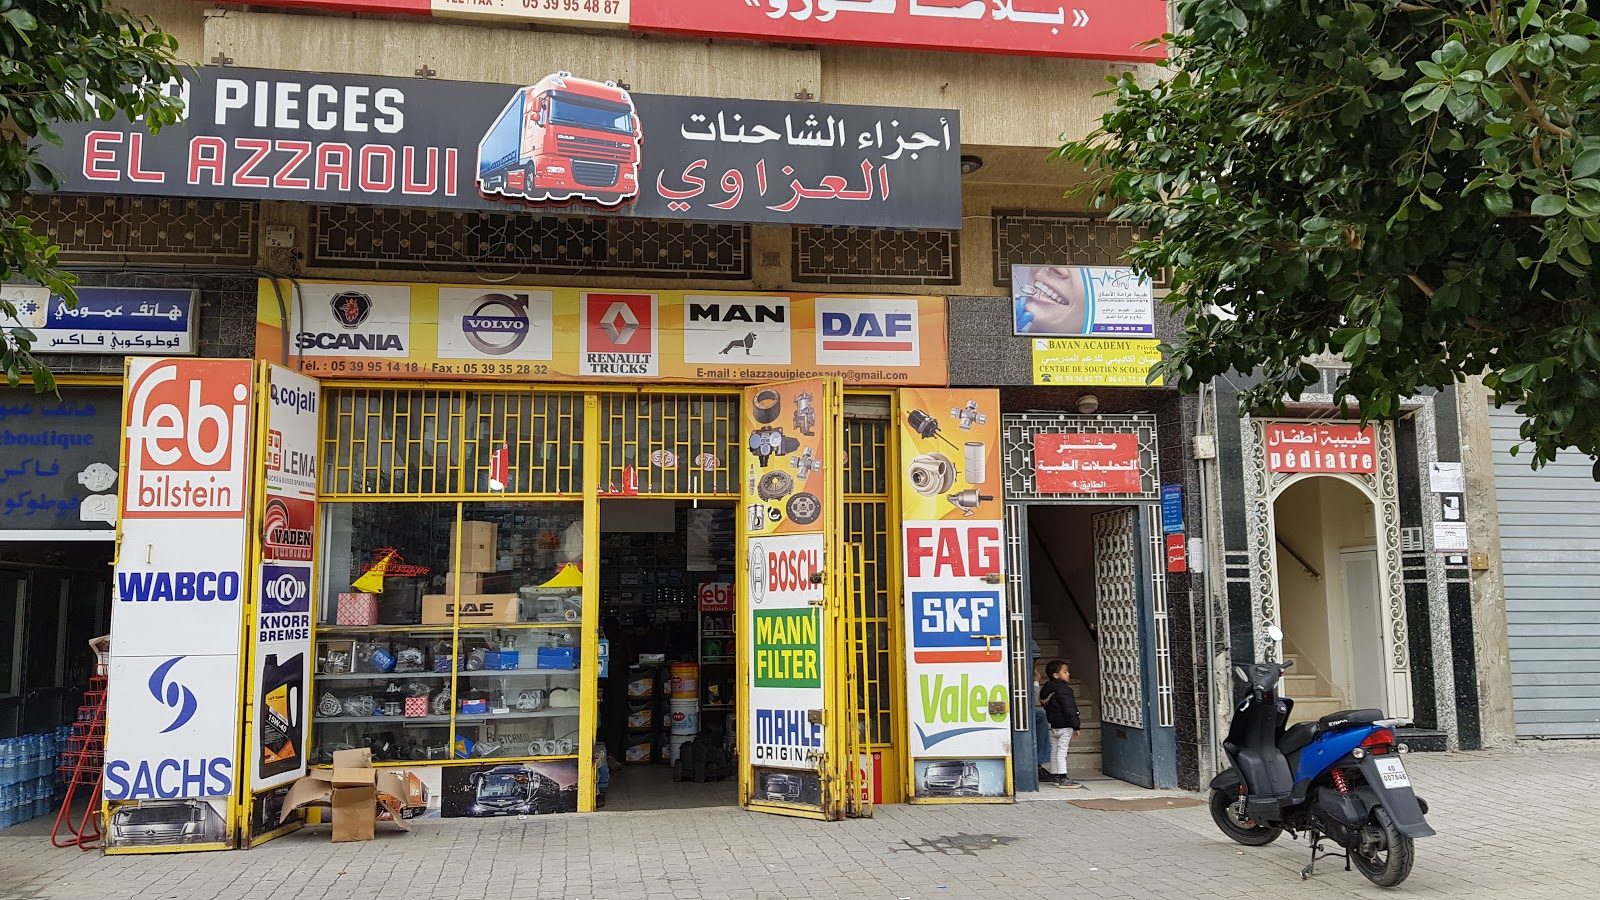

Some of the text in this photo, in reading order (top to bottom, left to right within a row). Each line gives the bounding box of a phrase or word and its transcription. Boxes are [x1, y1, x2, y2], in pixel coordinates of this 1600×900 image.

[564, 0, 579, 11] 95
[584, 0, 599, 13] 48
[604, 0, 620, 14] 87
[214, 78, 405, 134] PIECES
[680, 109, 951, 160] أجزاء الشاحنات
[82, 130, 458, 197] EL AZZAOUI
[656, 158, 889, 212] العزاوي
[54, 296, 182, 320] هاتف عمومي
[690, 303, 785, 323] MAN
[468, 319, 524, 329] VOLVO
[822, 312, 912, 337] DAF
[49, 331, 180, 350] فوطوكوبي فاكس
[295, 332, 404, 351] SCANIA
[1049, 341, 1080, 349] BAYAN
[1083, 341, 1131, 350] ACADEMY
[299, 360, 319, 371] Tél.
[331, 361, 345, 371] 05
[350, 361, 363, 371] 39
[368, 362, 381, 372] 95
[387, 362, 400, 372] 14
[405, 362, 417, 372] 18
[432, 363, 452, 373] Fax
[464, 363, 477, 373] 05
[482, 364, 495, 374] 39
[499, 364, 513, 374] 35
[517, 364, 530, 374] 28
[534, 364, 548, 374] 32
[587, 353, 651, 363] RENAULT
[590, 364, 647, 374] TRUCKS
[696, 368, 730, 378] E-mail
[280, 386, 315, 415] cojali
[126, 365, 248, 480] febi
[1056, 438, 1117, 454] مختبر
[1269, 427, 1371, 448] طبيبة أطفال
[284, 449, 316, 479] LEMA
[1038, 459, 1138, 474] التحليلات الطبية
[1270, 448, 1372, 470] pédiatre
[138, 475, 230, 507] bilstein
[275, 528, 311, 546] VADEN
[907, 528, 1000, 577] FAG
[769, 549, 818, 592] BOSCH
[118, 571, 239, 602] WABCO
[446, 603, 493, 612] DAF
[922, 598, 994, 632] SKF
[261, 614, 309, 629] KNORR
[757, 615, 817, 645] MANN
[260, 628, 309, 642] BREMSE
[757, 649, 818, 679] FILTER
[920, 673, 1008, 723] Valeo
[268, 713, 288, 733] 15W-40
[756, 709, 821, 747] MAHLE
[104, 757, 232, 800] SACHS
